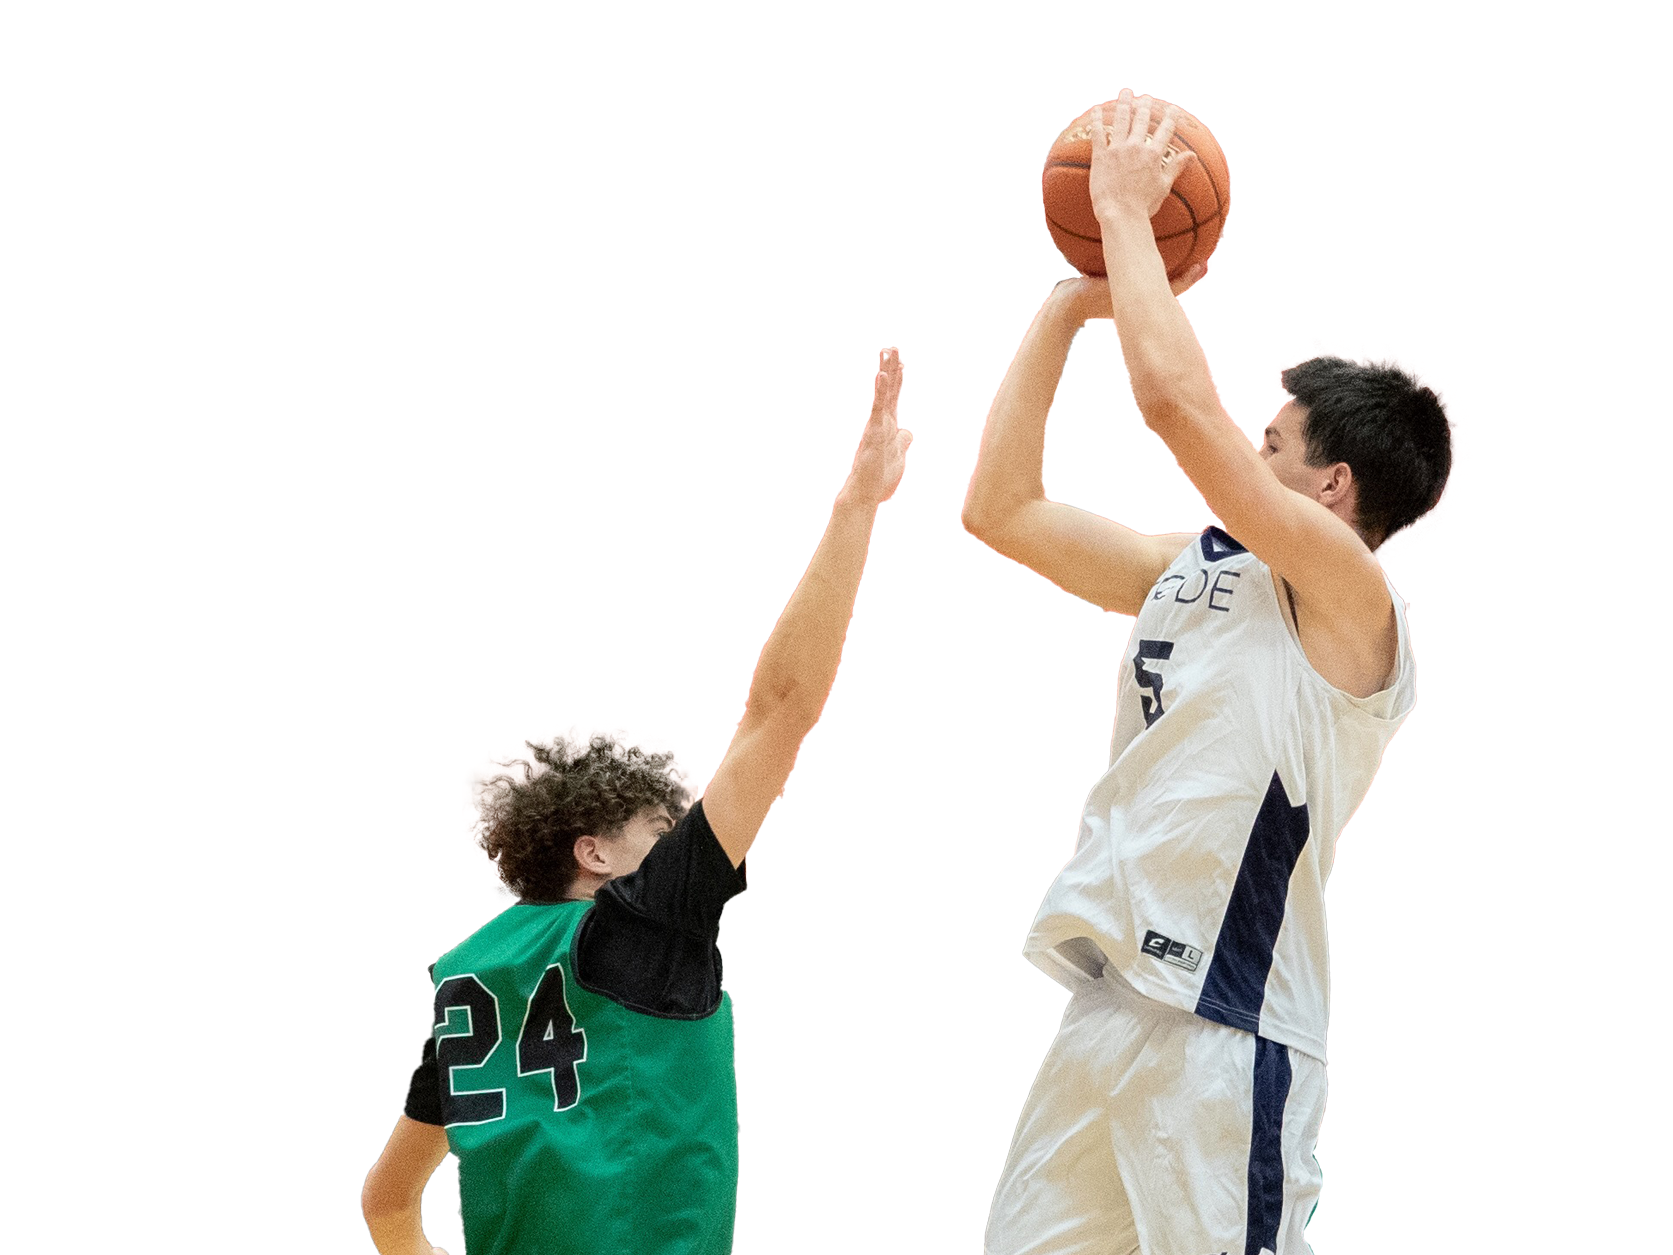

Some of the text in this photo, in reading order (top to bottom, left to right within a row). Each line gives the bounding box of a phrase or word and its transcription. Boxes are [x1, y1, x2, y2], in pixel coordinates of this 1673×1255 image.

[1133, 639, 1175, 730] 5
[1187, 949, 1195, 960] L
[433, 962, 588, 1130] 24
